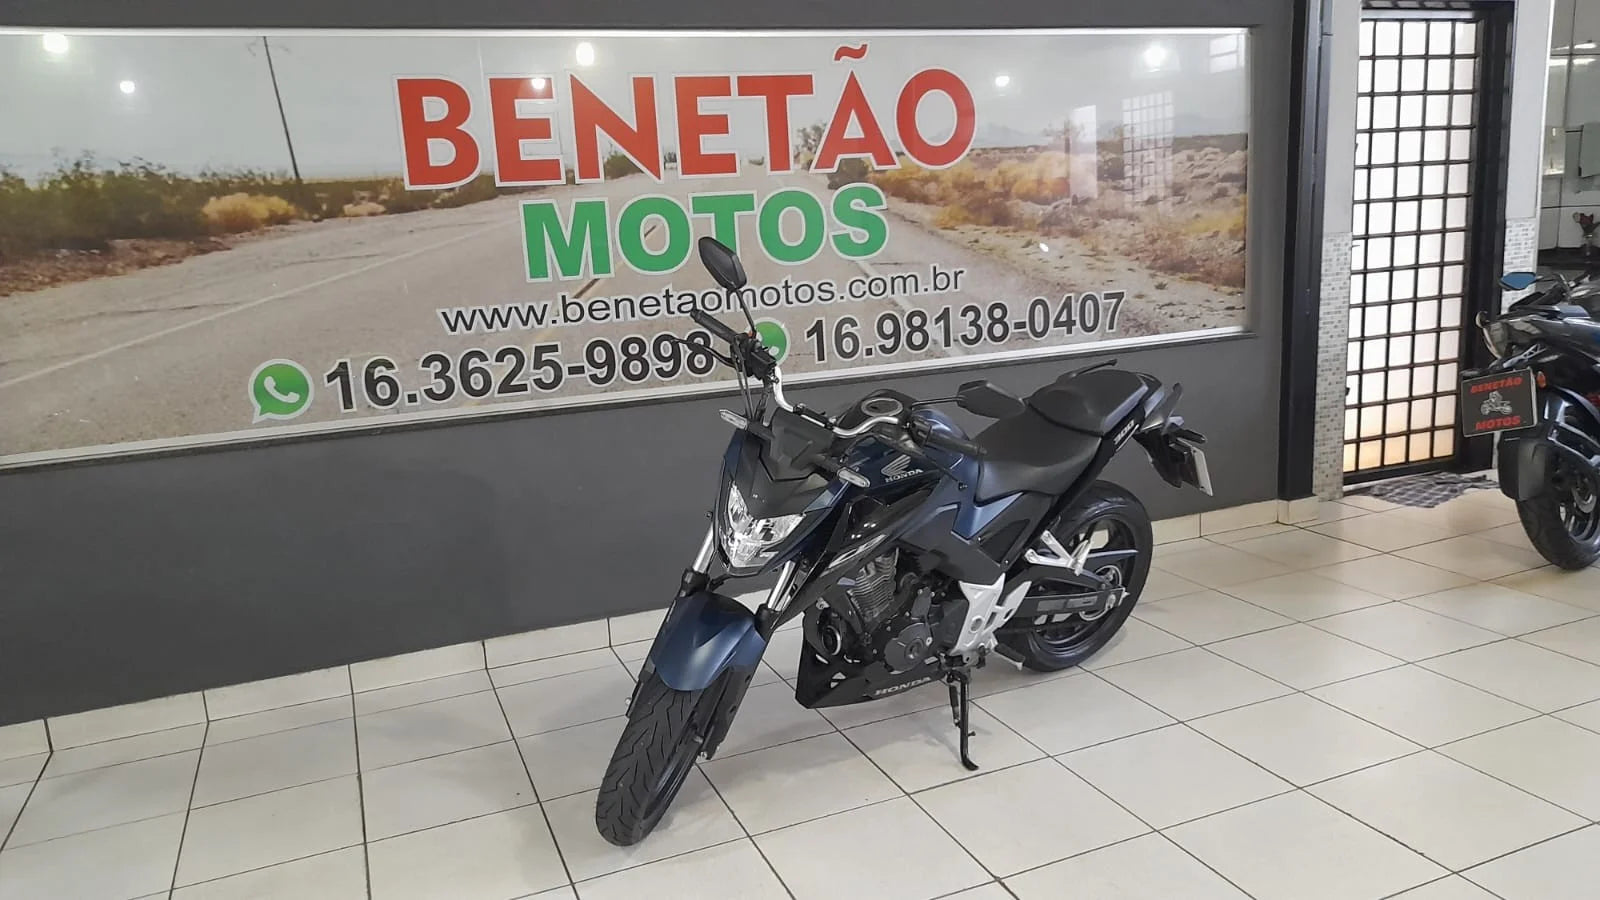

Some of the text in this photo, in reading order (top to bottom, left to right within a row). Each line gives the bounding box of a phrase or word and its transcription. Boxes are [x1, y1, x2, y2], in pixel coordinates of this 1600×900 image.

[397, 44, 976, 186] BENETÃO
[522, 186, 888, 279] MOTOS
[442, 266, 965, 333] www.benetaomotos.com.br
[806, 291, 1126, 362] 16.98138-0407
[326, 331, 714, 410] 16.3625-9898
[1475, 416, 1521, 430] MOTOS
[885, 468, 924, 482] HONDA
[875, 676, 931, 695] HONDA
